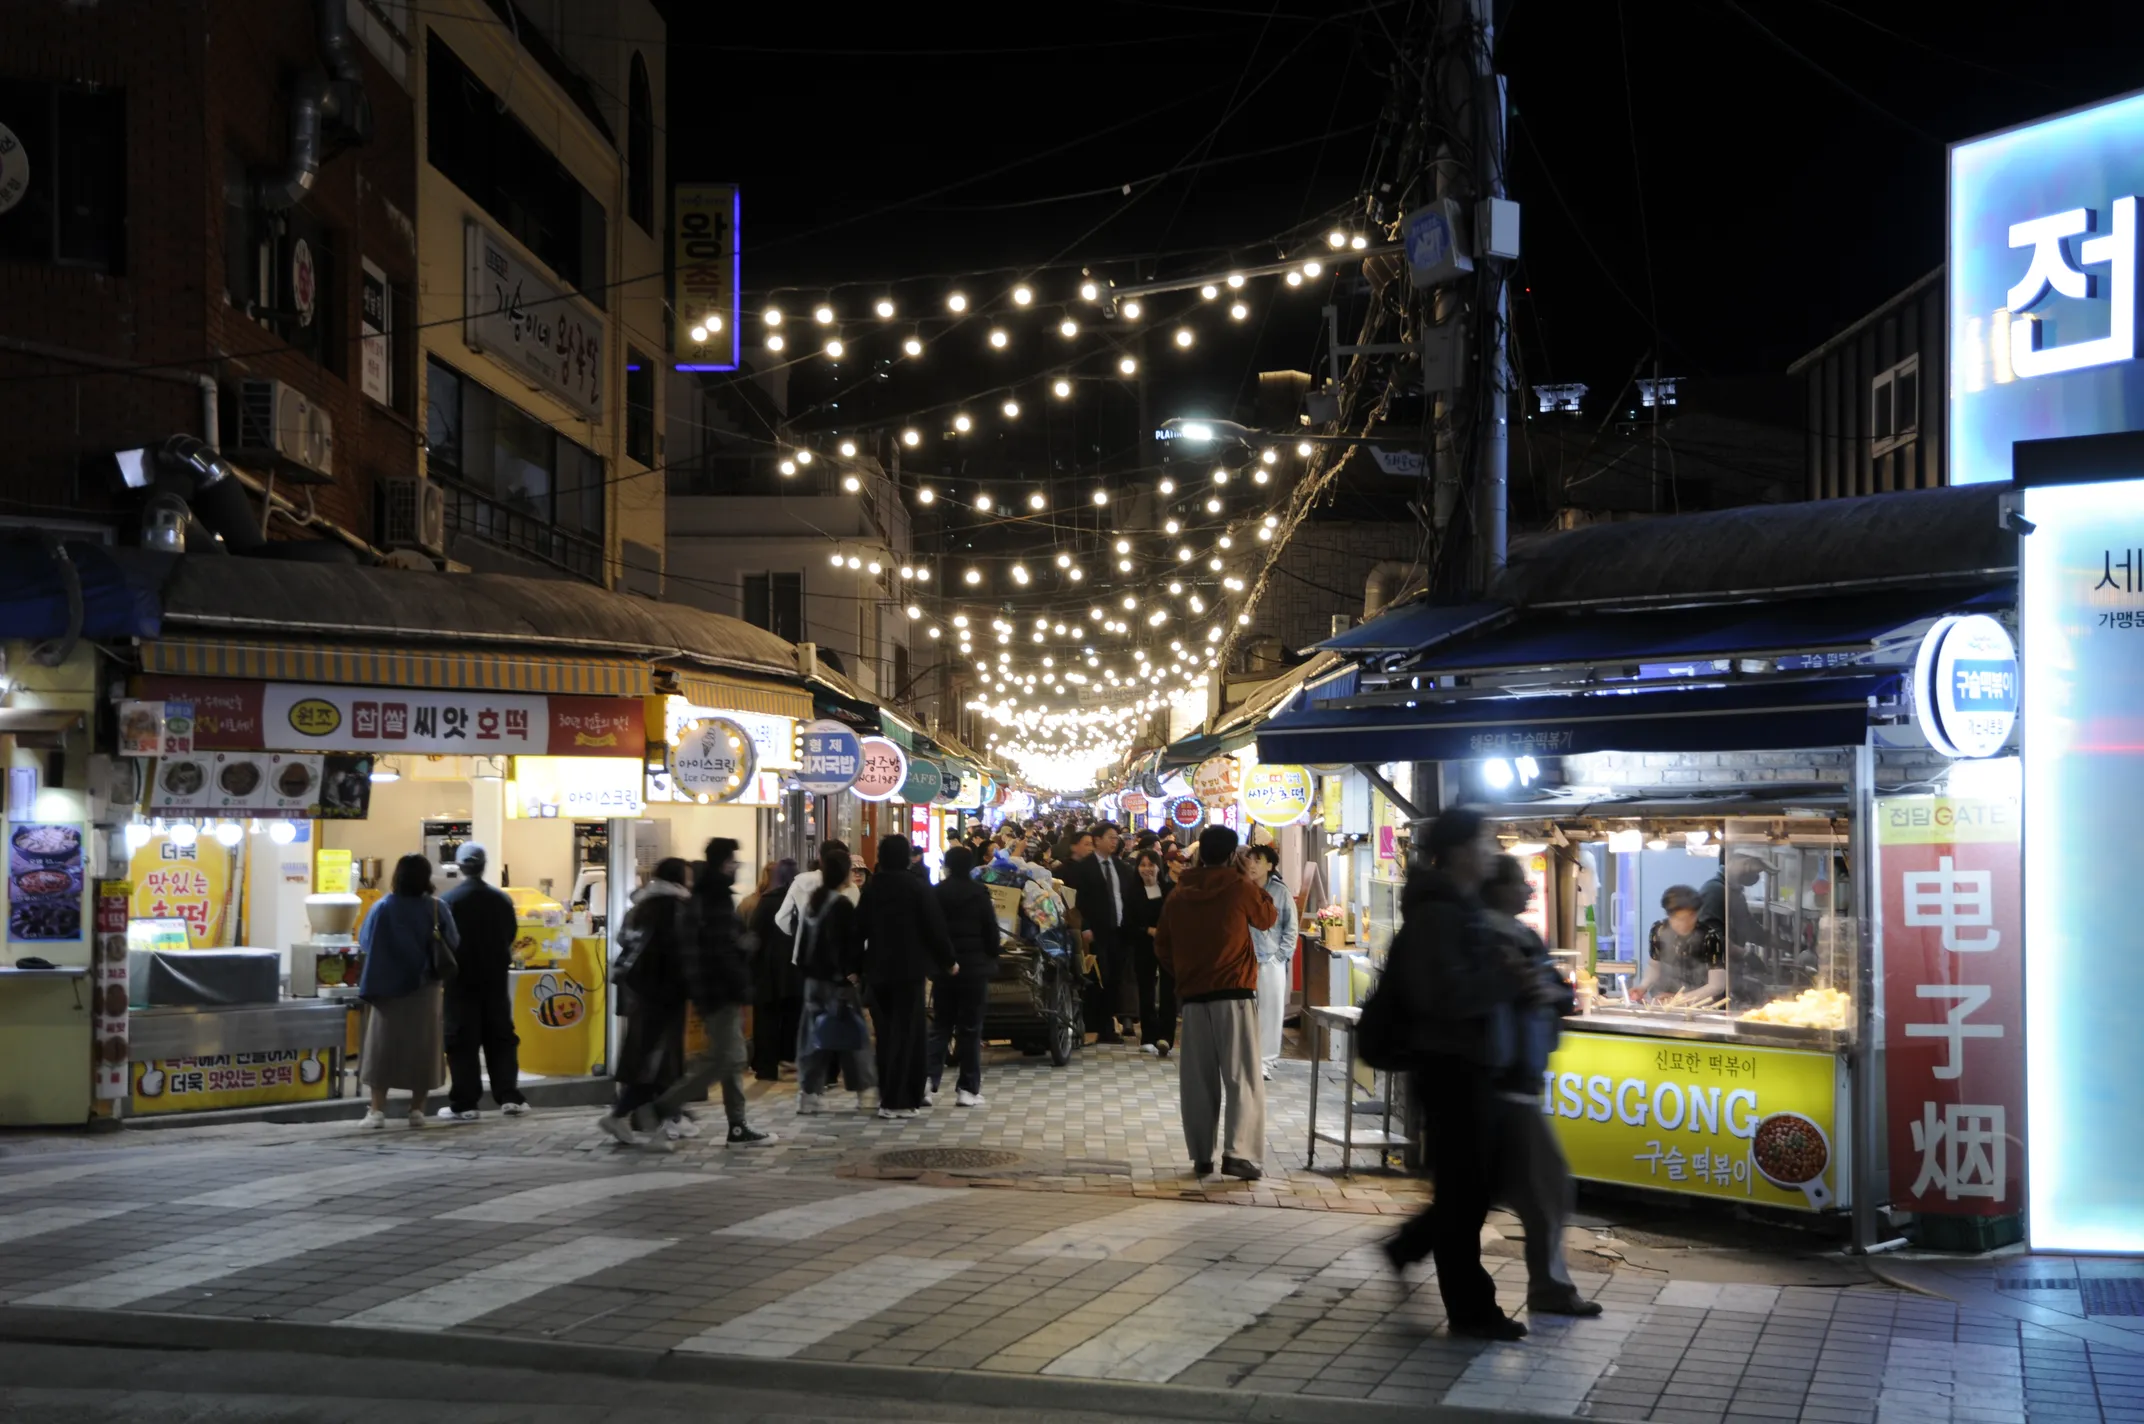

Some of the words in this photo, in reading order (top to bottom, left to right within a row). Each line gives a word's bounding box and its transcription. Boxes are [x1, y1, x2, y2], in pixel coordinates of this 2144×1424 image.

[2006, 196, 2136, 378] 전
[2095, 548, 2143, 592] 세
[1956, 671, 2013, 699] 구슬떡볶이
[297, 706, 333, 726] 원조
[356, 707, 406, 733] 찹쌀
[414, 706, 468, 740] 씨앗
[476, 707, 528, 740] 호떡
[679, 759, 735, 774] 아이스크림
[865, 756, 900, 772] 영주방
[684, 774, 698, 782] Ice
[858, 774, 877, 783] NCE
[878, 774, 899, 784] 1987
[906, 774, 937, 785] CAFE
[568, 790, 637, 811] 아이스크림
[149, 872, 206, 895] 맛있는
[1903, 856, 2006, 1202] 电子烟
[1655, 1049, 1701, 1074] 신묘한
[1708, 1054, 1756, 1080] 떡볶이
[171, 1072, 203, 1092] 더욱
[209, 1069, 256, 1090] 맛있는
[262, 1066, 293, 1086] 호떡
[1541, 1072, 1760, 1139] ISSGONG
